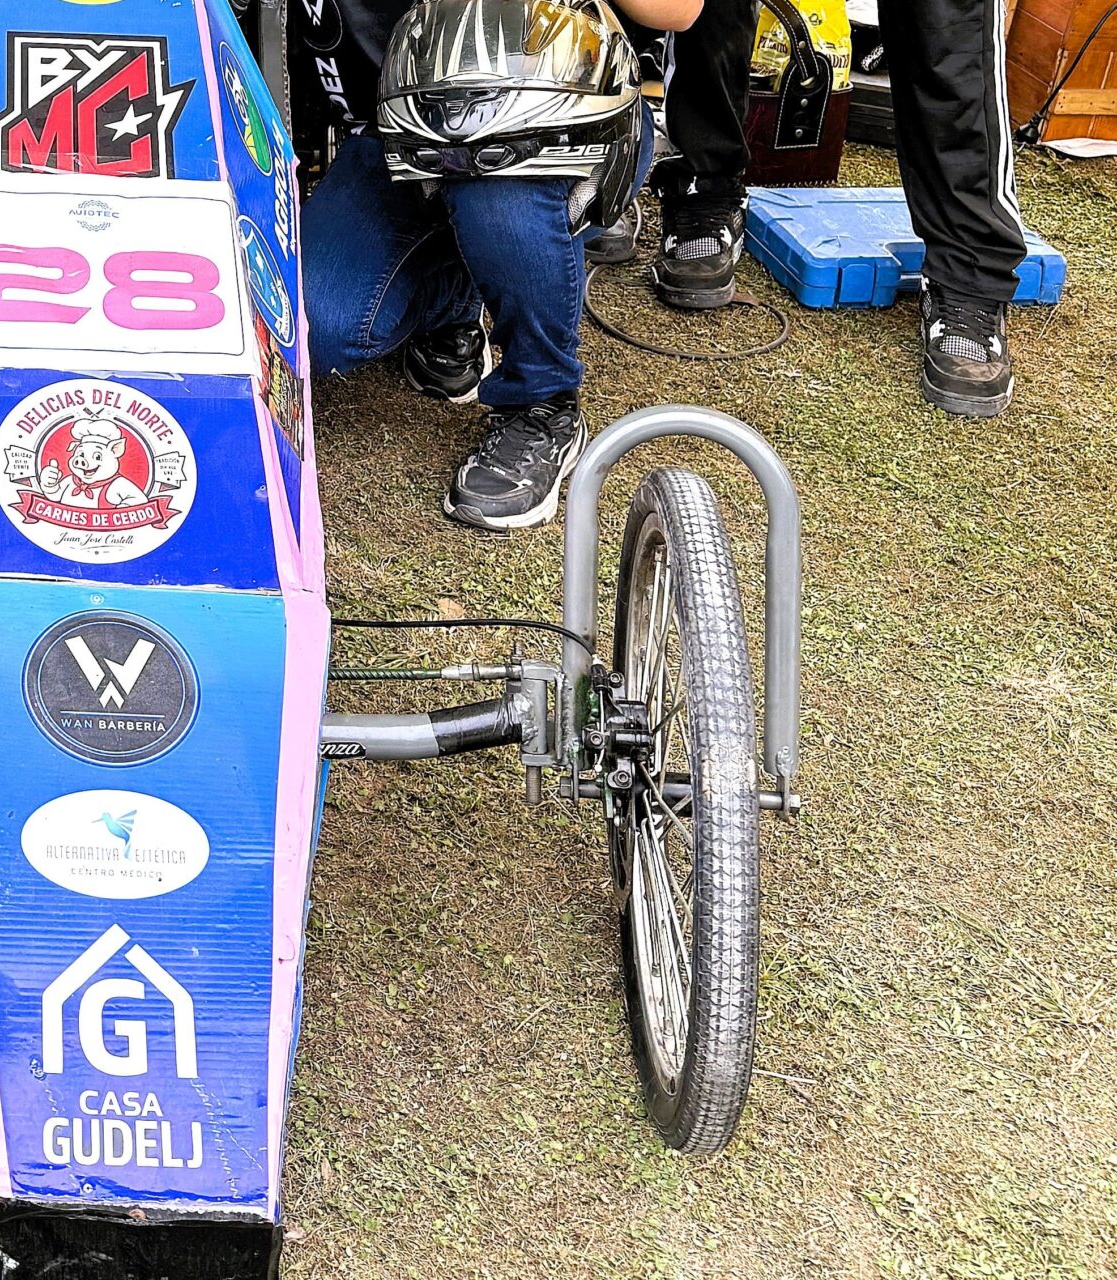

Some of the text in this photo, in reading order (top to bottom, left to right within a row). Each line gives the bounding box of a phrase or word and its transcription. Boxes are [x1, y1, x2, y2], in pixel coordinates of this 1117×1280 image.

[28, 46, 127, 110] BY
[68, 209, 120, 219] AUTOTEC
[15, 387, 176, 442] DELICIAS DEL NORTE
[34, 501, 155, 527] CARNES DE CERDO
[61, 718, 166, 732] WAN BARBERÍA
[45, 844, 120, 861] ALTERNATIVA
[79, 1089, 164, 1117] CASA
[42, 1116, 203, 1169] GUDELJ
